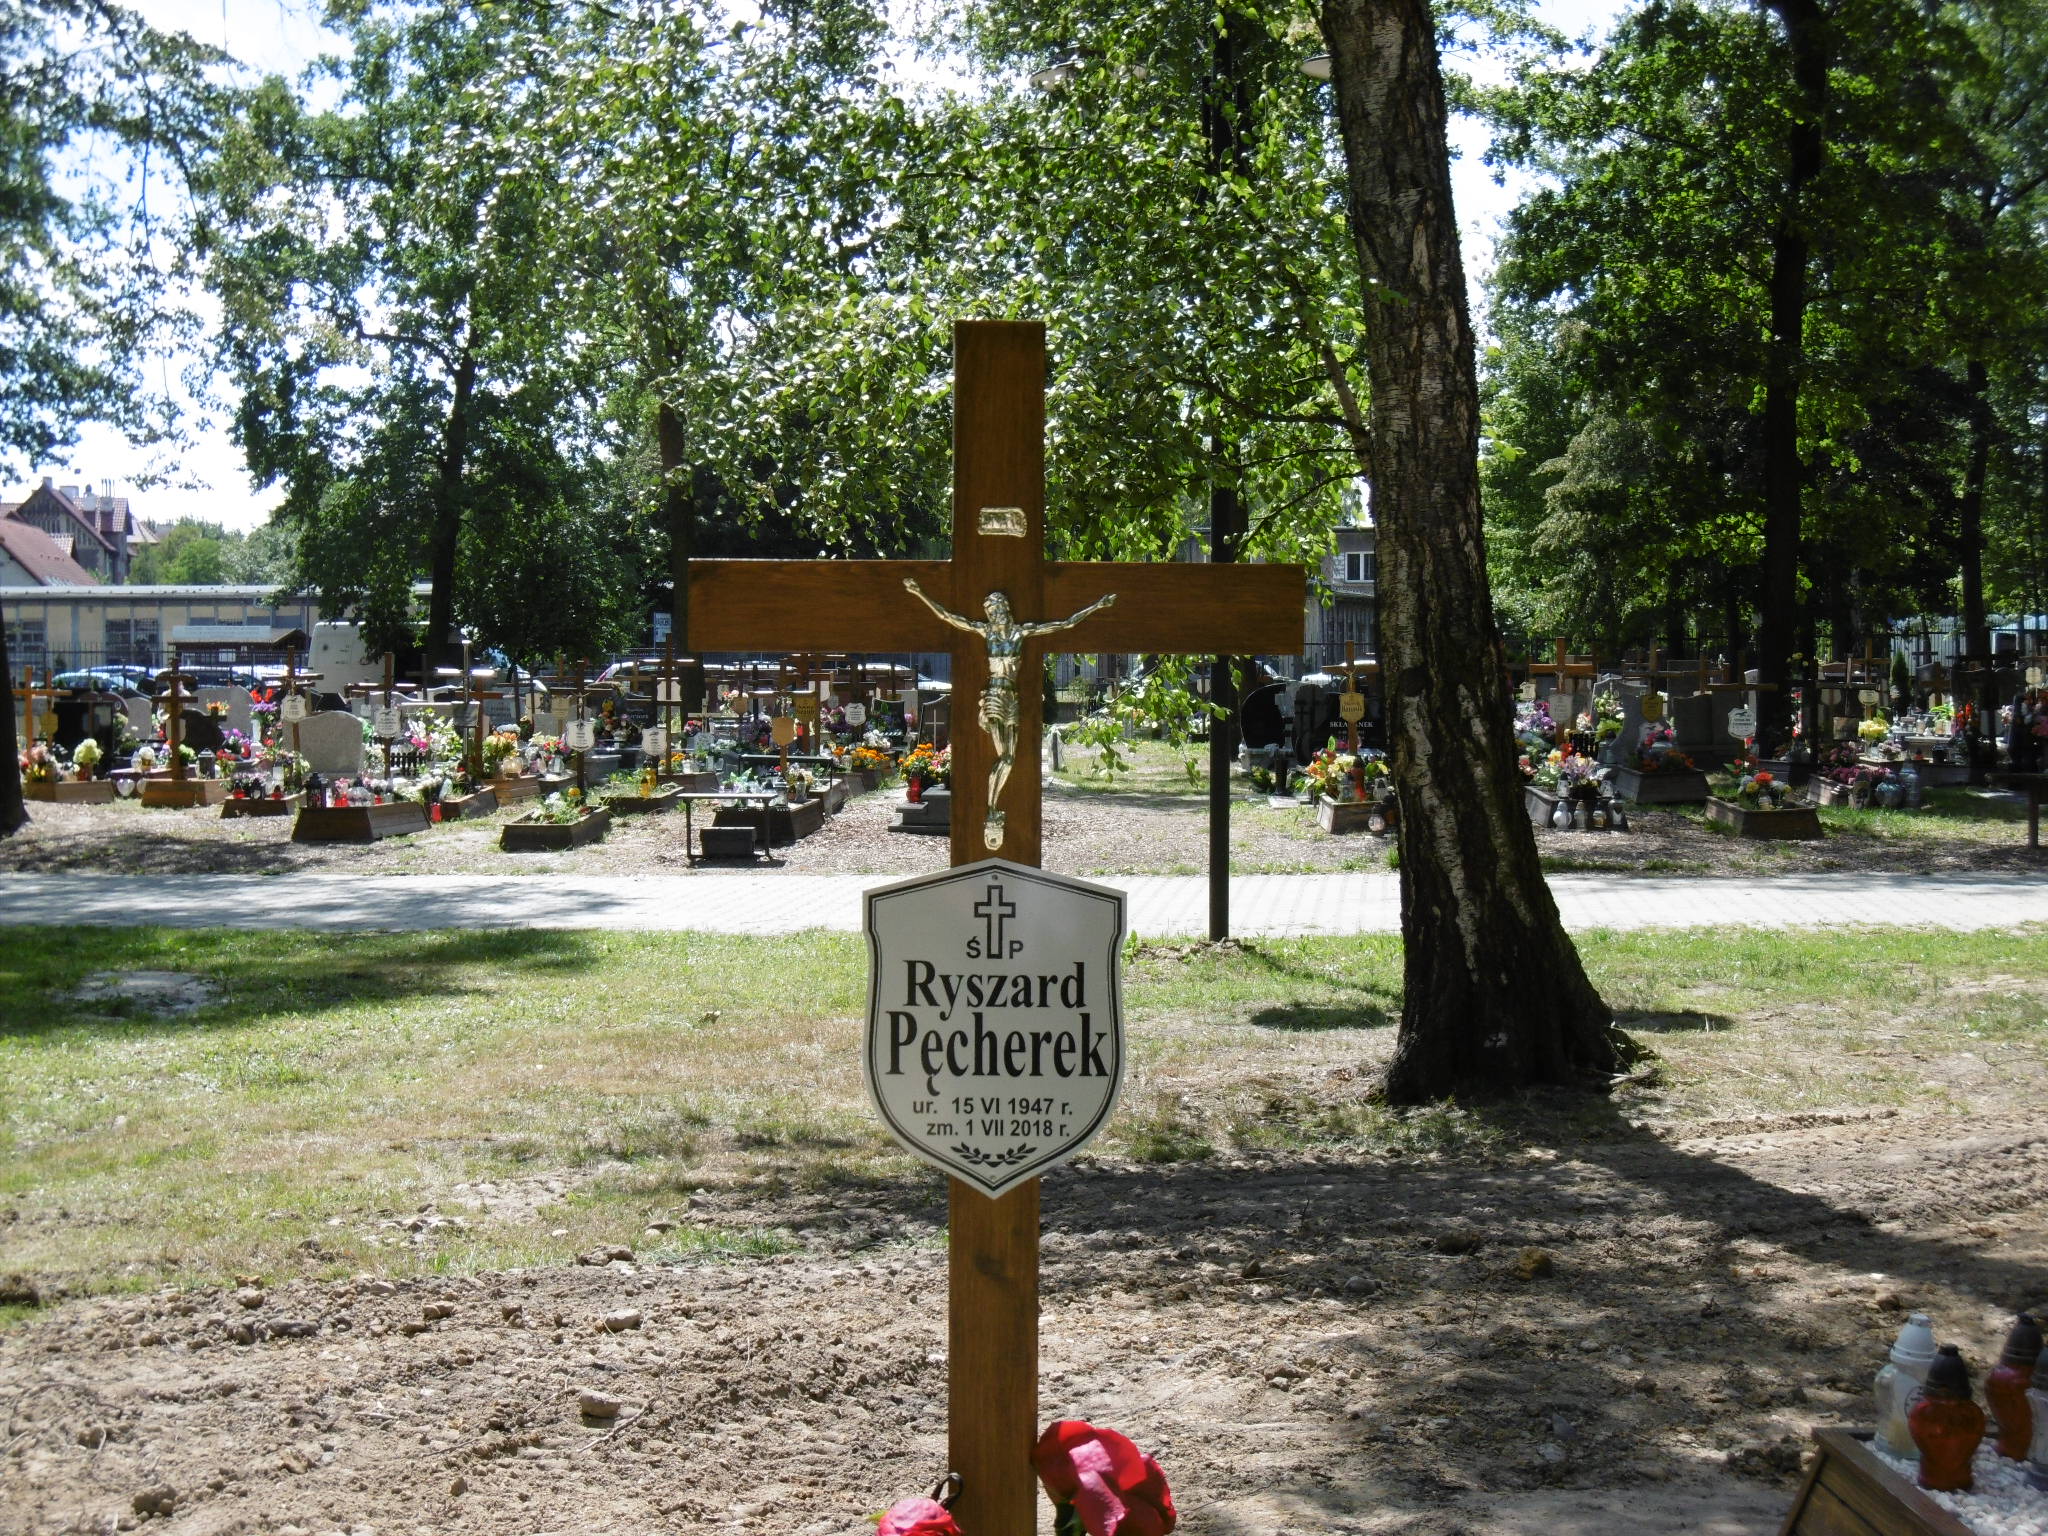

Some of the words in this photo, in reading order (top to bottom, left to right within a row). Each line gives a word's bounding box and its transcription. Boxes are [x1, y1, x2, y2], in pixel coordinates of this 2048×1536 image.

[966, 936, 981, 959] Ś
[1008, 940, 1024, 959] P
[902, 959, 1087, 1021] Ryszard
[885, 1010, 1109, 1097] Pęcherek
[912, 1101, 938, 1115] ur.
[951, 1097, 974, 1115] 15
[980, 1097, 1001, 1115] VI
[1007, 1097, 1054, 1115] 1947
[1061, 1102, 1073, 1116] r.
[926, 1122, 958, 1137] zm.
[965, 1119, 973, 1137] 1
[981, 1119, 1005, 1137] VII
[1010, 1119, 1053, 1137] 2018
[1059, 1123, 1070, 1137] r.
